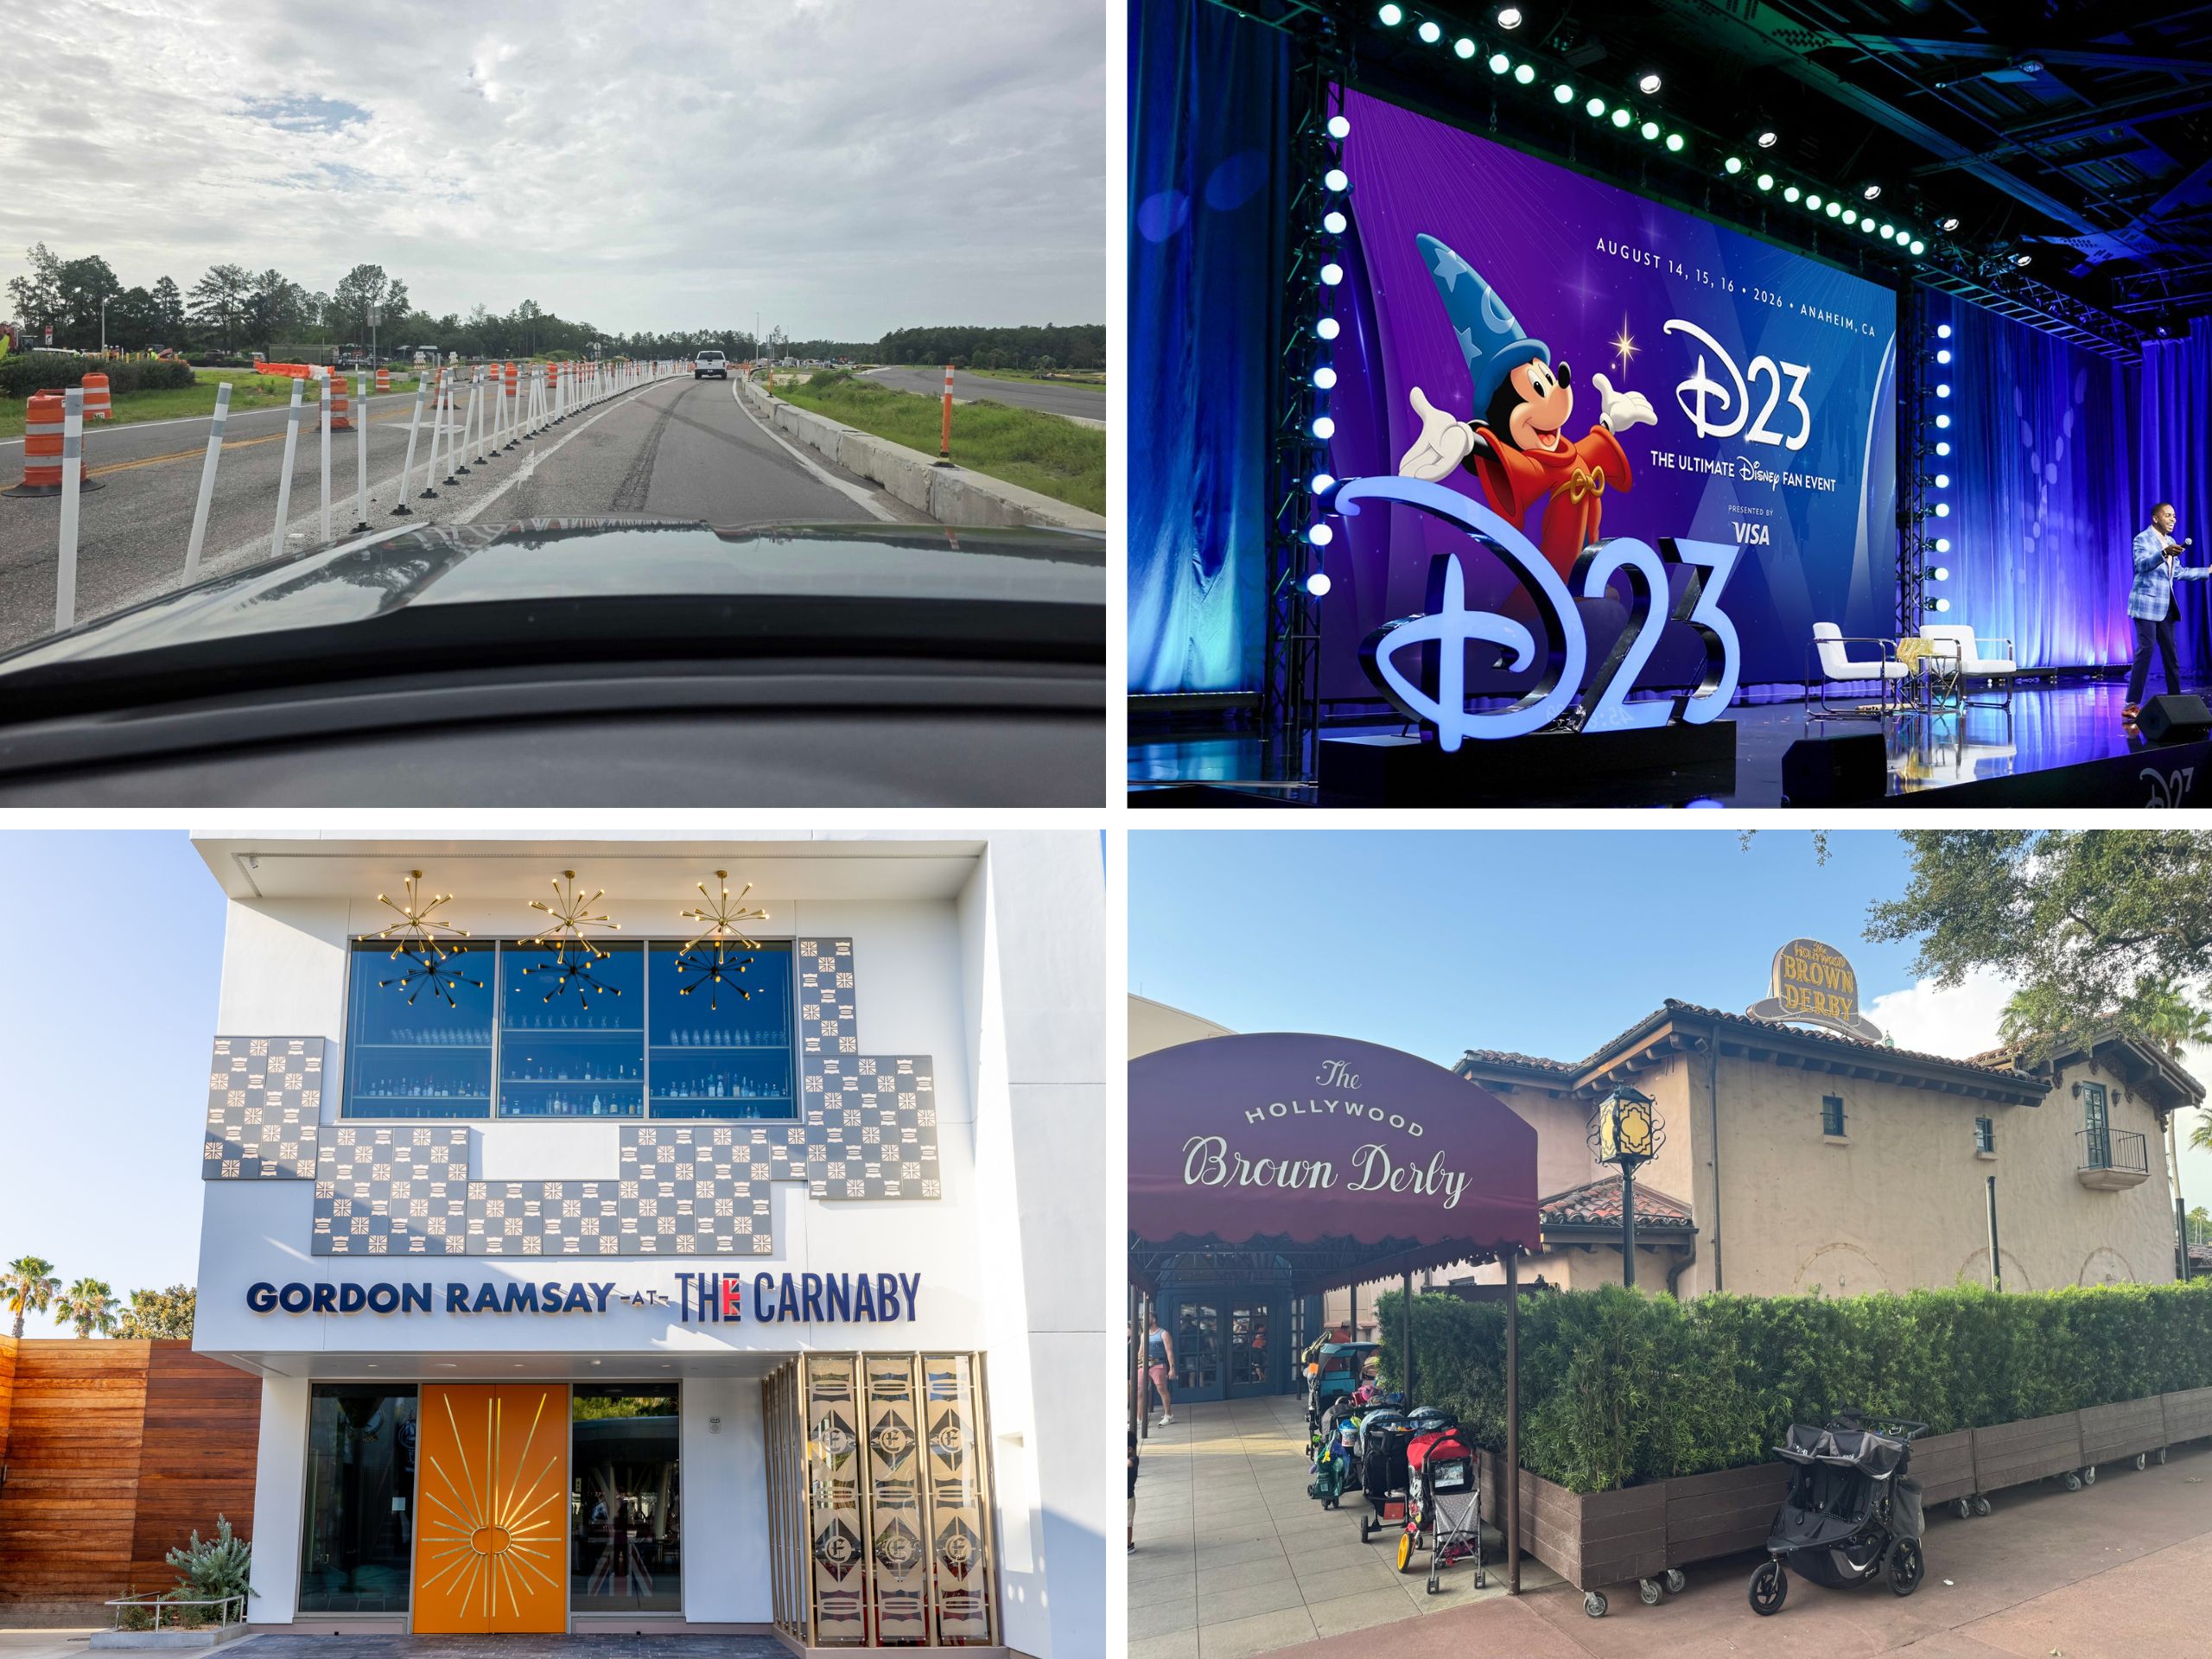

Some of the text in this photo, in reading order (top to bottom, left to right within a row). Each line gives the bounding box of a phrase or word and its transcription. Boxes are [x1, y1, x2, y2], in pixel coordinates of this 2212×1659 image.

[1596, 238, 1875, 337] AUGUST 14, 15, 16 2026 ANAHEIM, CA
[1662, 319, 1811, 451] D23
[1650, 450, 1675, 468] THE
[1678, 454, 1735, 478] ULTIMATE
[1783, 472, 1803, 487] FAN
[1805, 475, 1836, 493] EVENT
[1728, 505, 1774, 517] PRESENTED BY
[1731, 521, 1770, 546] VISA
[1319, 475, 1741, 753] D23
[1783, 955, 1853, 994] BROWN
[1784, 983, 1853, 1020] DERBY
[1315, 1059, 1362, 1090] The
[1245, 1100, 1424, 1137] HOLLYWOOD
[1182, 1135, 1473, 1210] Brown Derby
[246, 1281, 431, 1313] GORDON
[446, 1281, 616, 1313] RAMSAY
[674, 1272, 741, 1322] THE
[753, 1272, 921, 1323] CARNABY
